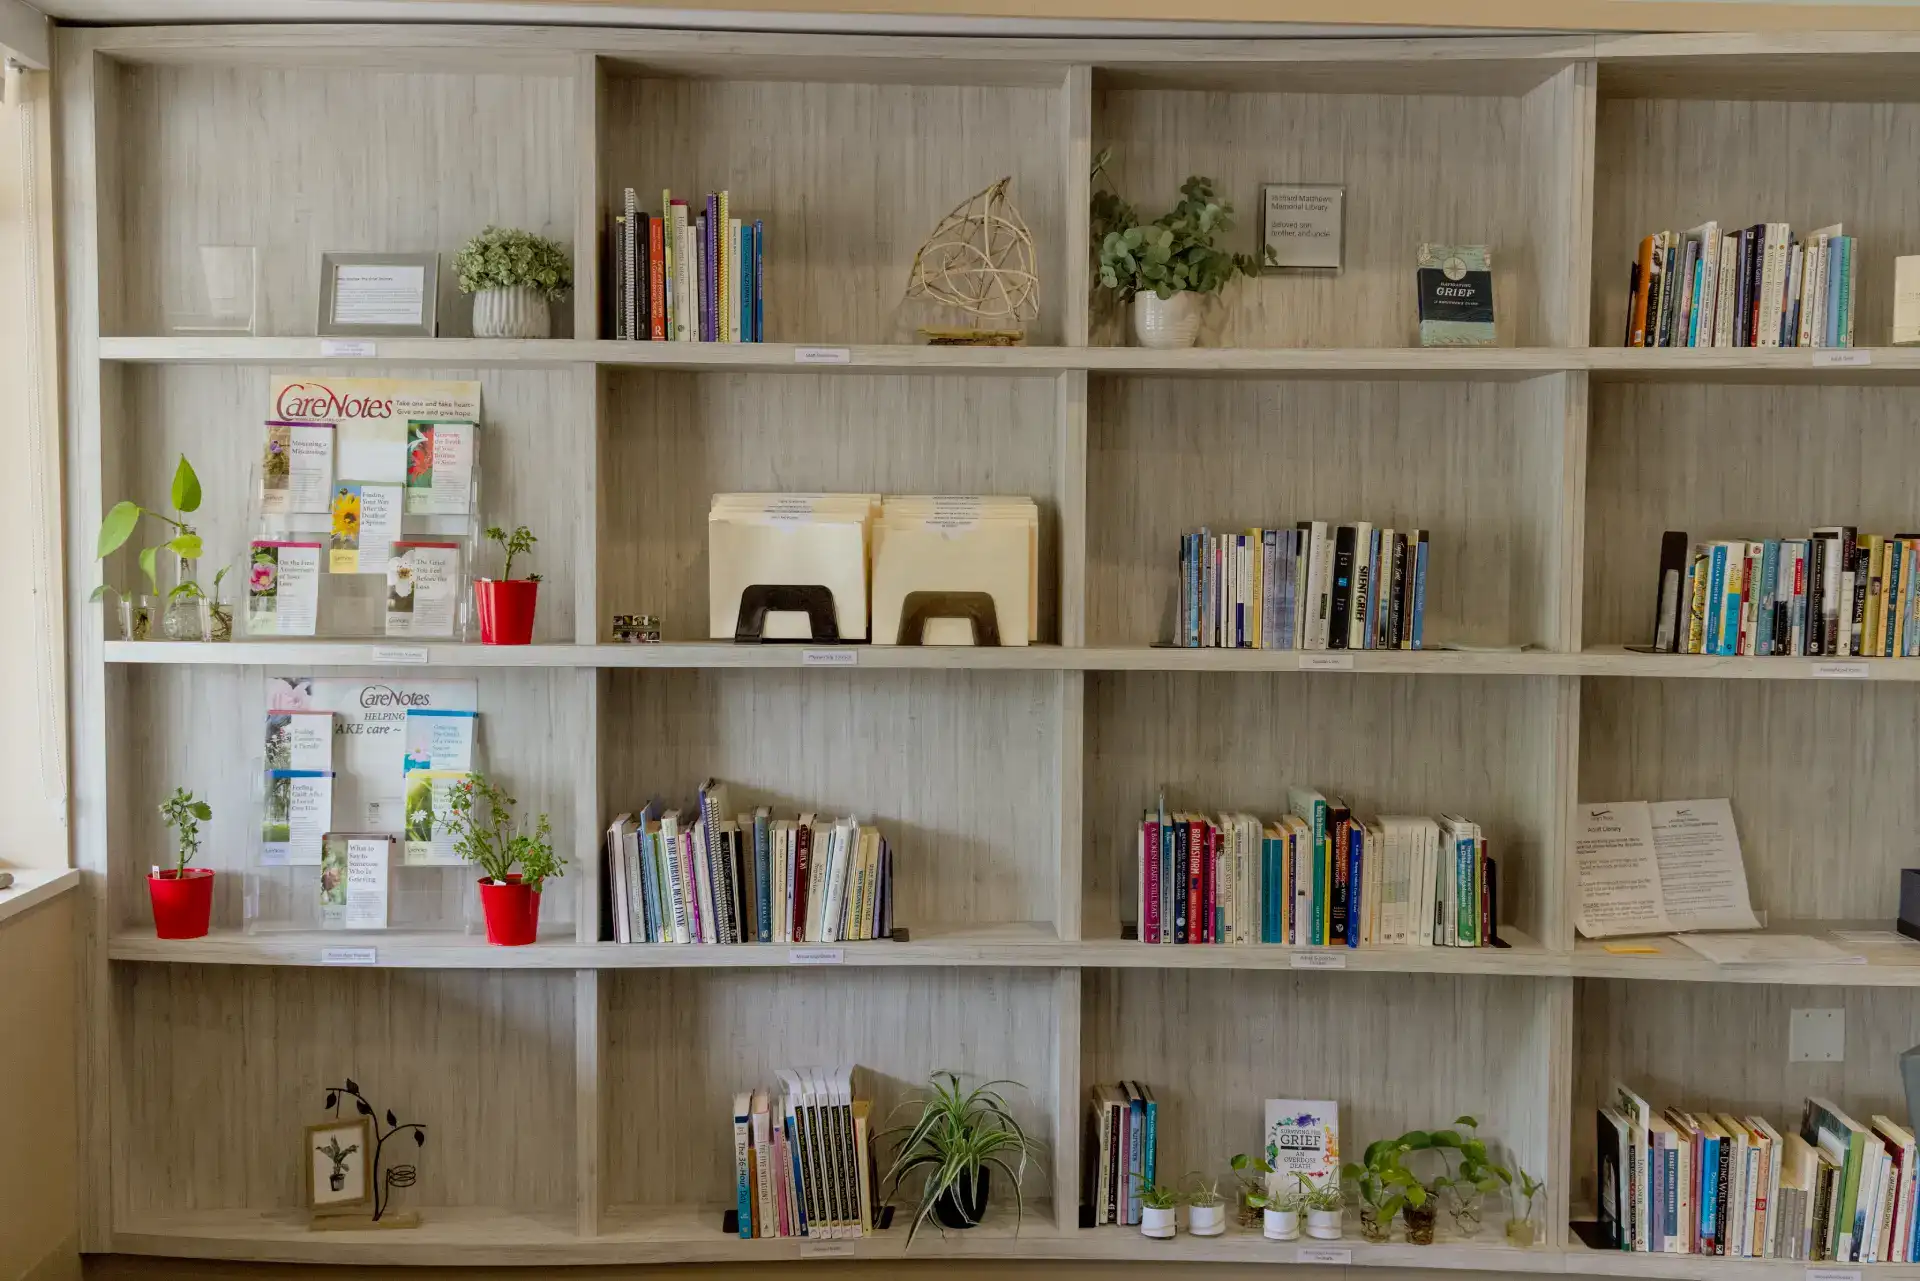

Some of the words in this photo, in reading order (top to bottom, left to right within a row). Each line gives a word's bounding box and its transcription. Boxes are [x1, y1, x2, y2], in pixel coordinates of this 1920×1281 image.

[1304, 204, 1328, 212] Library
[1436, 286, 1475, 298] GRIEF
[276, 382, 393, 421] CareNotes
[1358, 566, 1368, 593] SILENT
[1356, 594, 1366, 622] GRIEF
[1856, 599, 1864, 622] SHACK
[360, 684, 430, 708] CareNotes
[364, 712, 405, 721] HELPING
[366, 724, 390, 734] care
[666, 838, 676, 855] DEAR
[1191, 829, 1201, 874] BRAINSTORM
[668, 857, 681, 888] BARBARA,
[672, 889, 683, 905] DEAR
[855, 886, 863, 913] PREGNANCY
[674, 906, 685, 927] LYNNE
[1280, 1134, 1321, 1146] GRIEF
[1720, 1156, 1728, 1181] DYING
[760, 1168, 768, 1200] INVITATIONS
[1719, 1182, 1727, 1203] WELL
